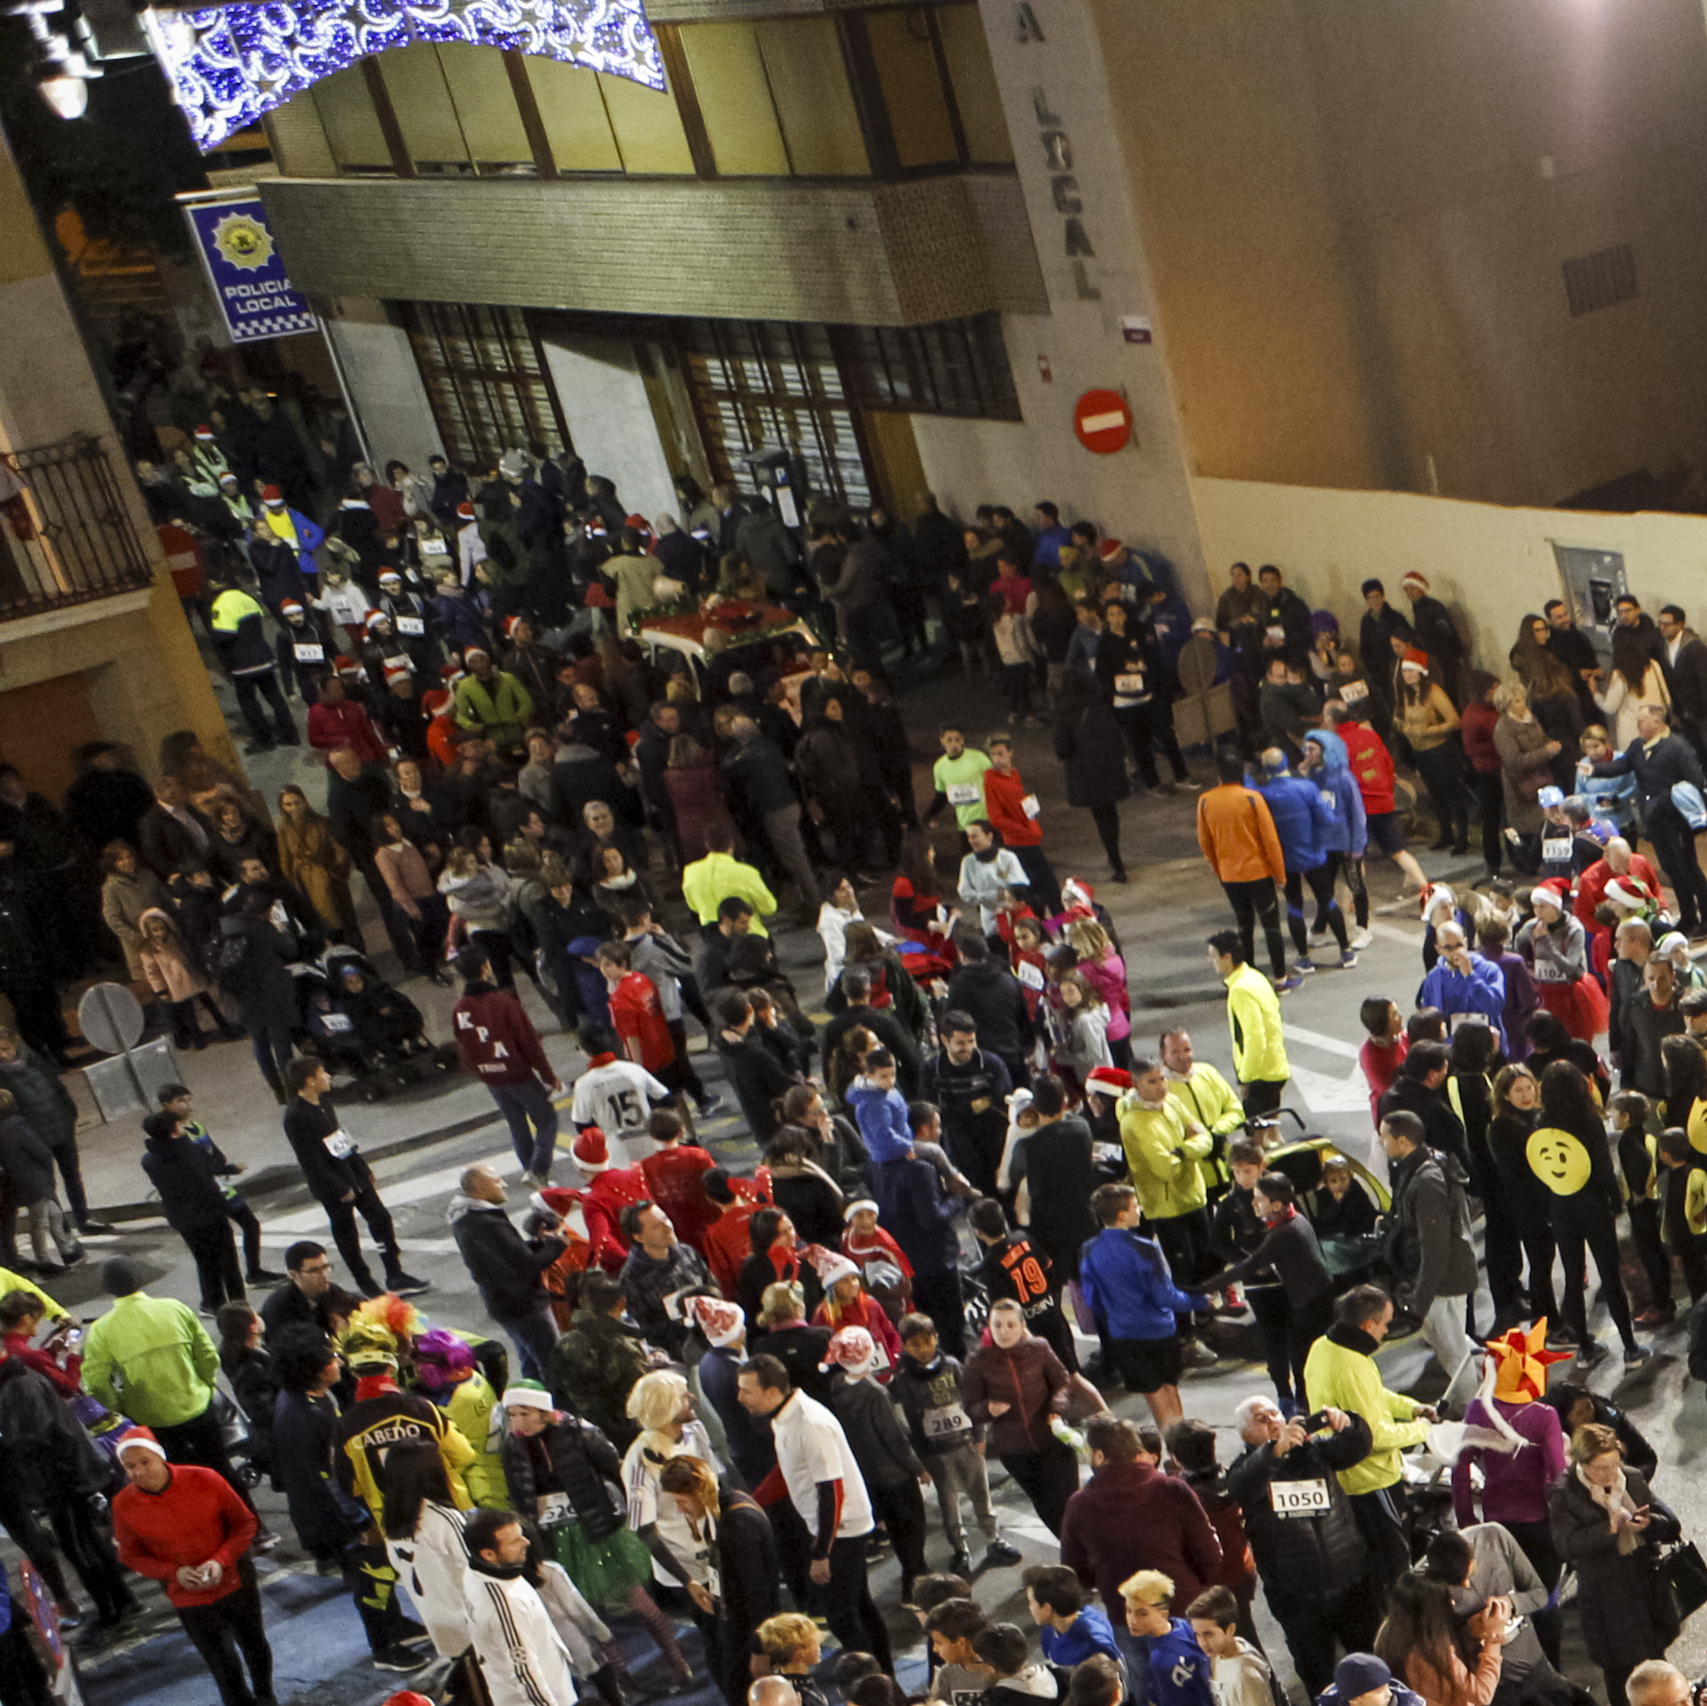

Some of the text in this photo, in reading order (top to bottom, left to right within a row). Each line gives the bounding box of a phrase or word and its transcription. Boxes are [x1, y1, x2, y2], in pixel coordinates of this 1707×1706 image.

[1032, 85, 1101, 301] LOCAL
[225, 279, 292, 299] POLICIA
[236, 295, 297, 313] LOCAL
[608, 1090, 645, 1128] 15
[1011, 1256, 1048, 1304] 19
[354, 1424, 421, 1451] CABEDO
[1278, 1491, 1324, 1509] 1050
